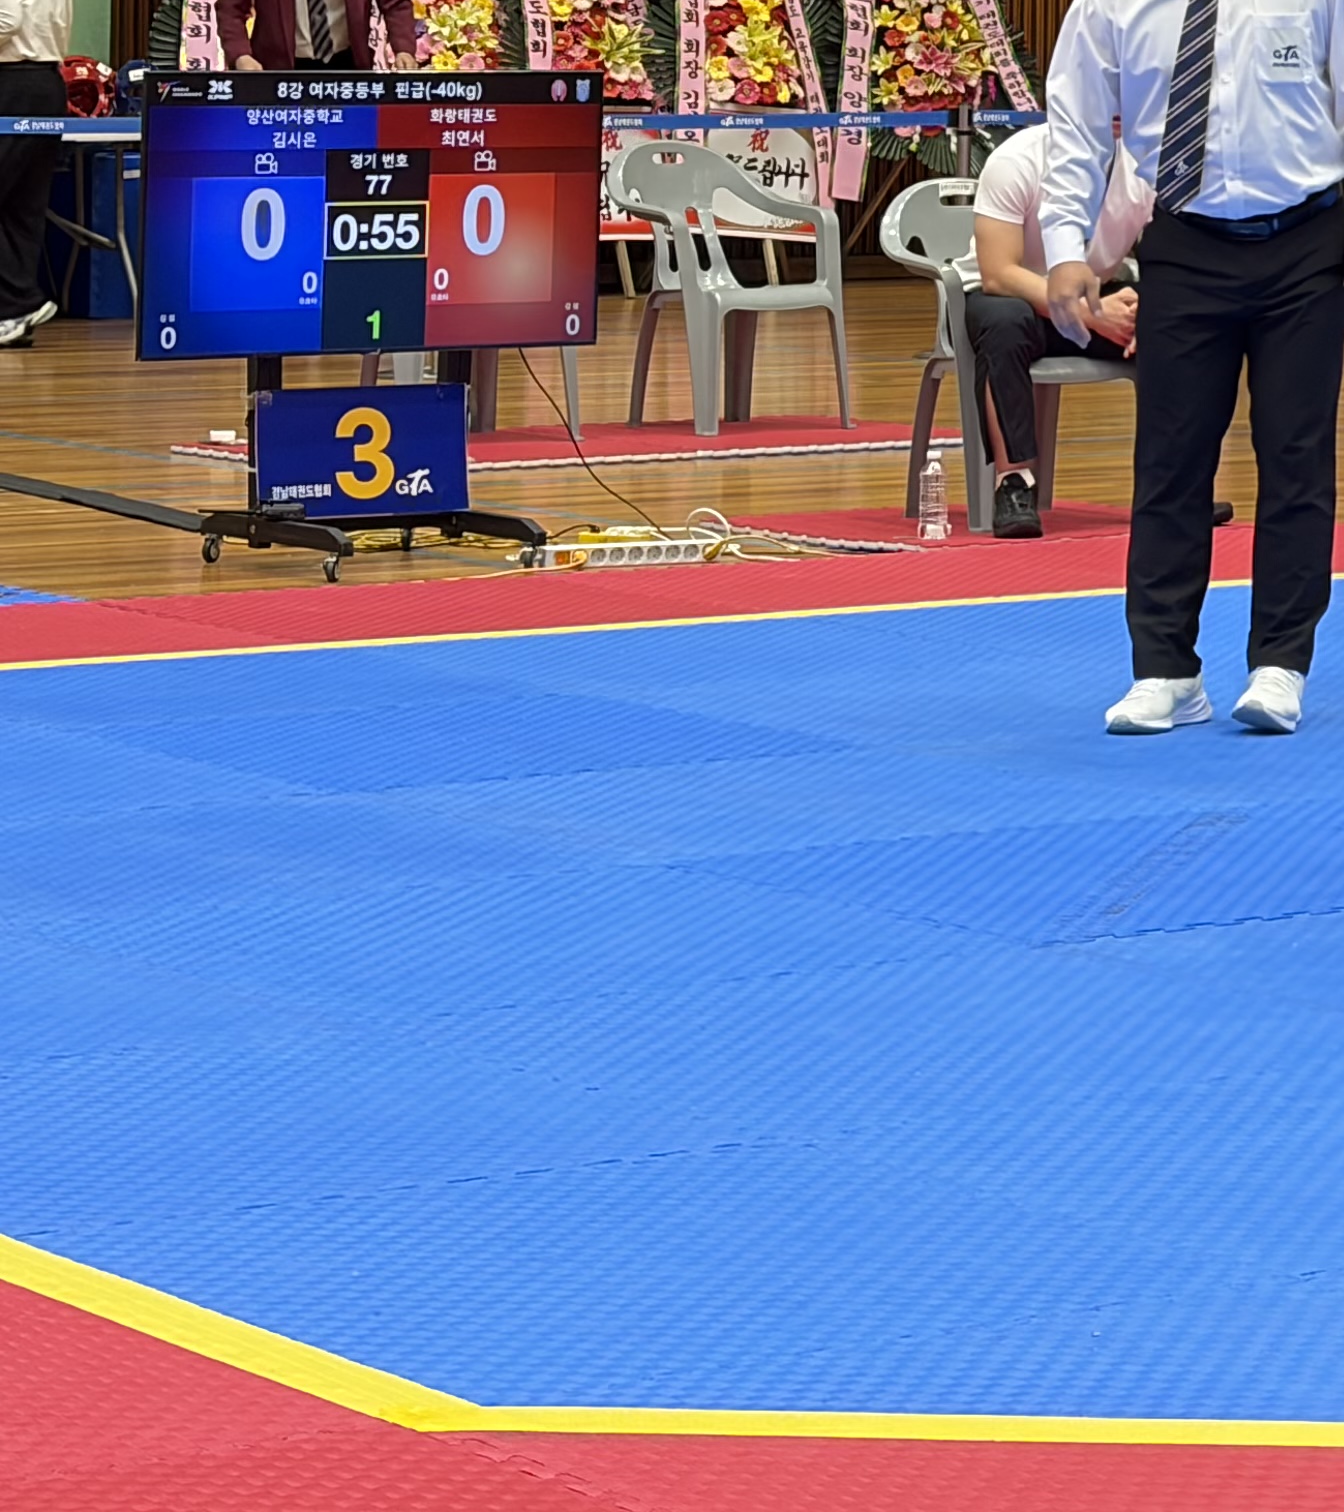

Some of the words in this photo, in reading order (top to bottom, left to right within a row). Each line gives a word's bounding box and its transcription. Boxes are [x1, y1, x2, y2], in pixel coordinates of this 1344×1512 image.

[682, 38, 703, 80] 회장
[845, 46, 867, 82] 회장
[1272, 45, 1300, 62] GTA
[277, 81, 304, 100] 8강
[308, 81, 386, 100] 여자중등부
[246, 108, 344, 125] 양산여자중학교
[429, 108, 498, 124] 화랑태권도
[272, 131, 318, 149] 김시온
[441, 130, 486, 147] 최연서
[748, 130, 771, 153] 祝
[350, 153, 377, 170] 경기
[381, 152, 409, 169] 번호
[365, 174, 393, 196] 77
[241, 187, 286, 262] 0
[462, 184, 506, 256] 0
[332, 212, 421, 252] 0:55
[302, 271, 318, 294] 0
[433, 268, 449, 291] 0
[366, 310, 382, 340] 1
[565, 313, 580, 336] 0
[160, 326, 177, 350] 0
[335, 406, 396, 501] 3
[395, 468, 434, 497] GTA
